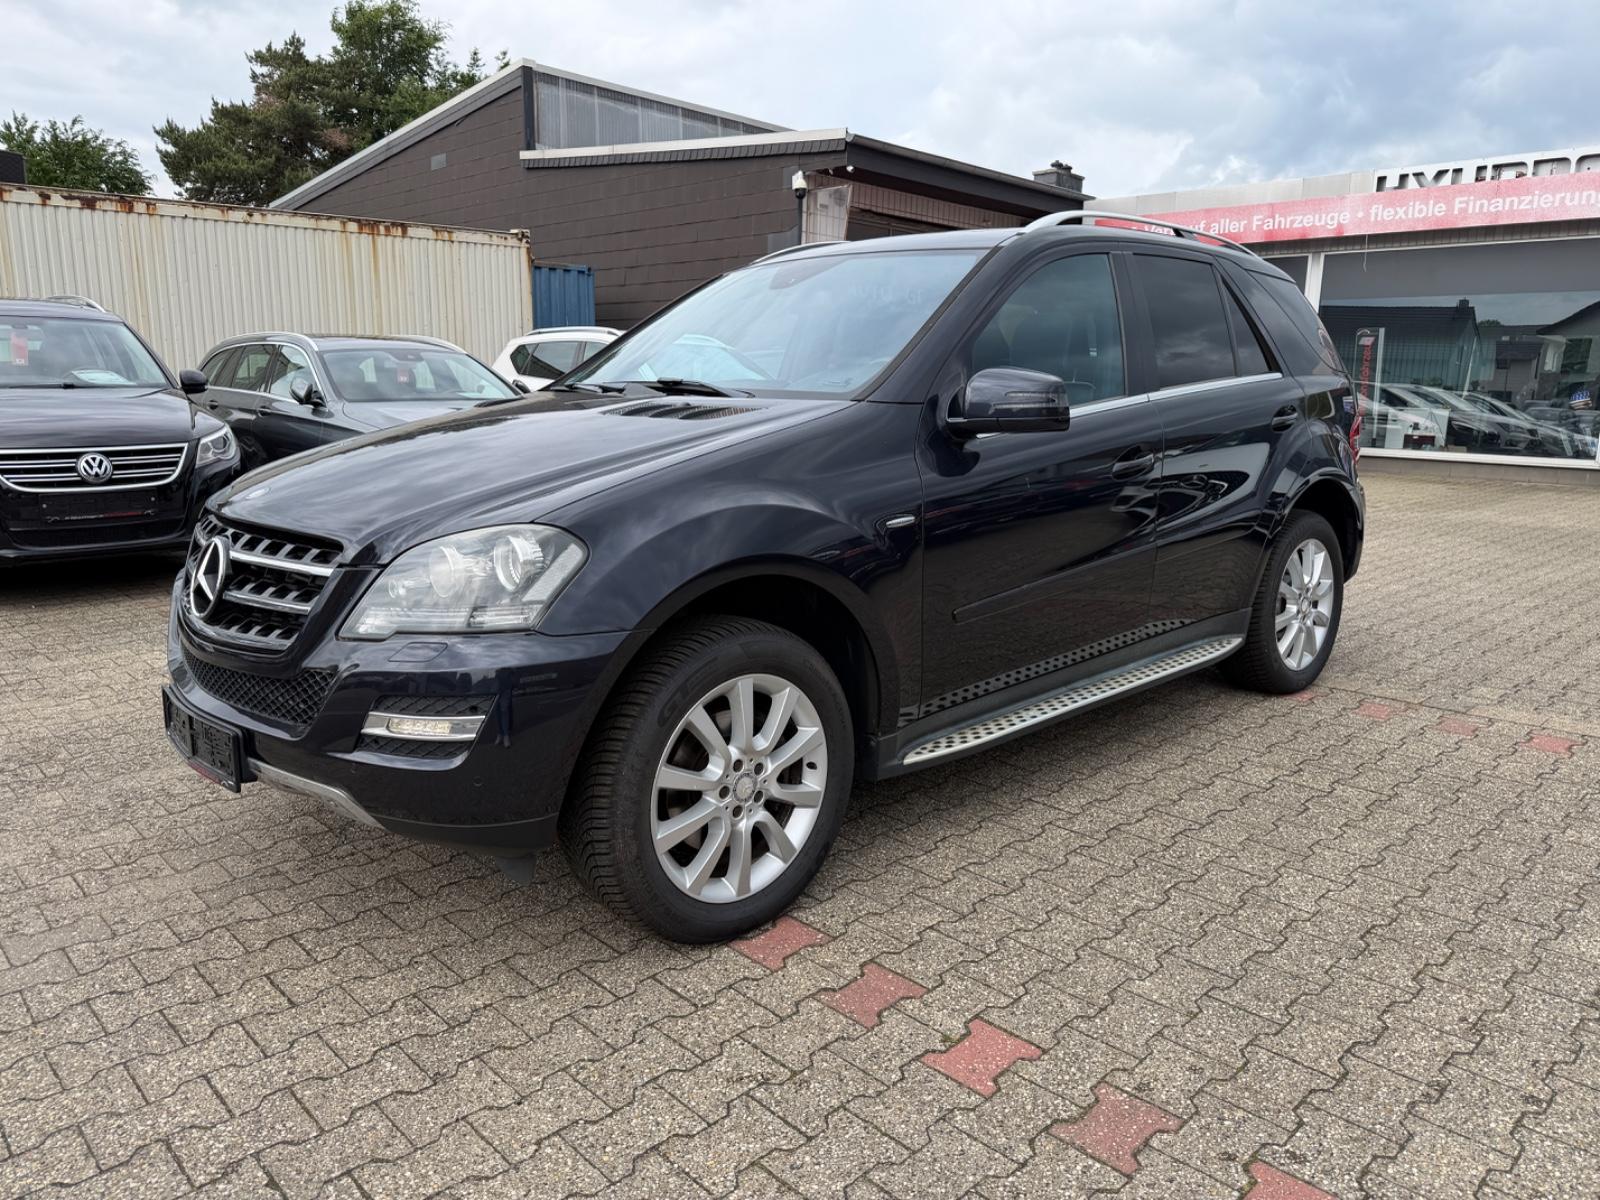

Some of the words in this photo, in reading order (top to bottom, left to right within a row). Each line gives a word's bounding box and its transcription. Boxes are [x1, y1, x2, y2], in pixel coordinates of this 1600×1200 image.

[1210, 218, 1247, 235] aller
[1252, 210, 1350, 232] Fahrzeuge
[1370, 200, 1446, 222] flexible
[1453, 190, 1600, 215] Finanzierun
